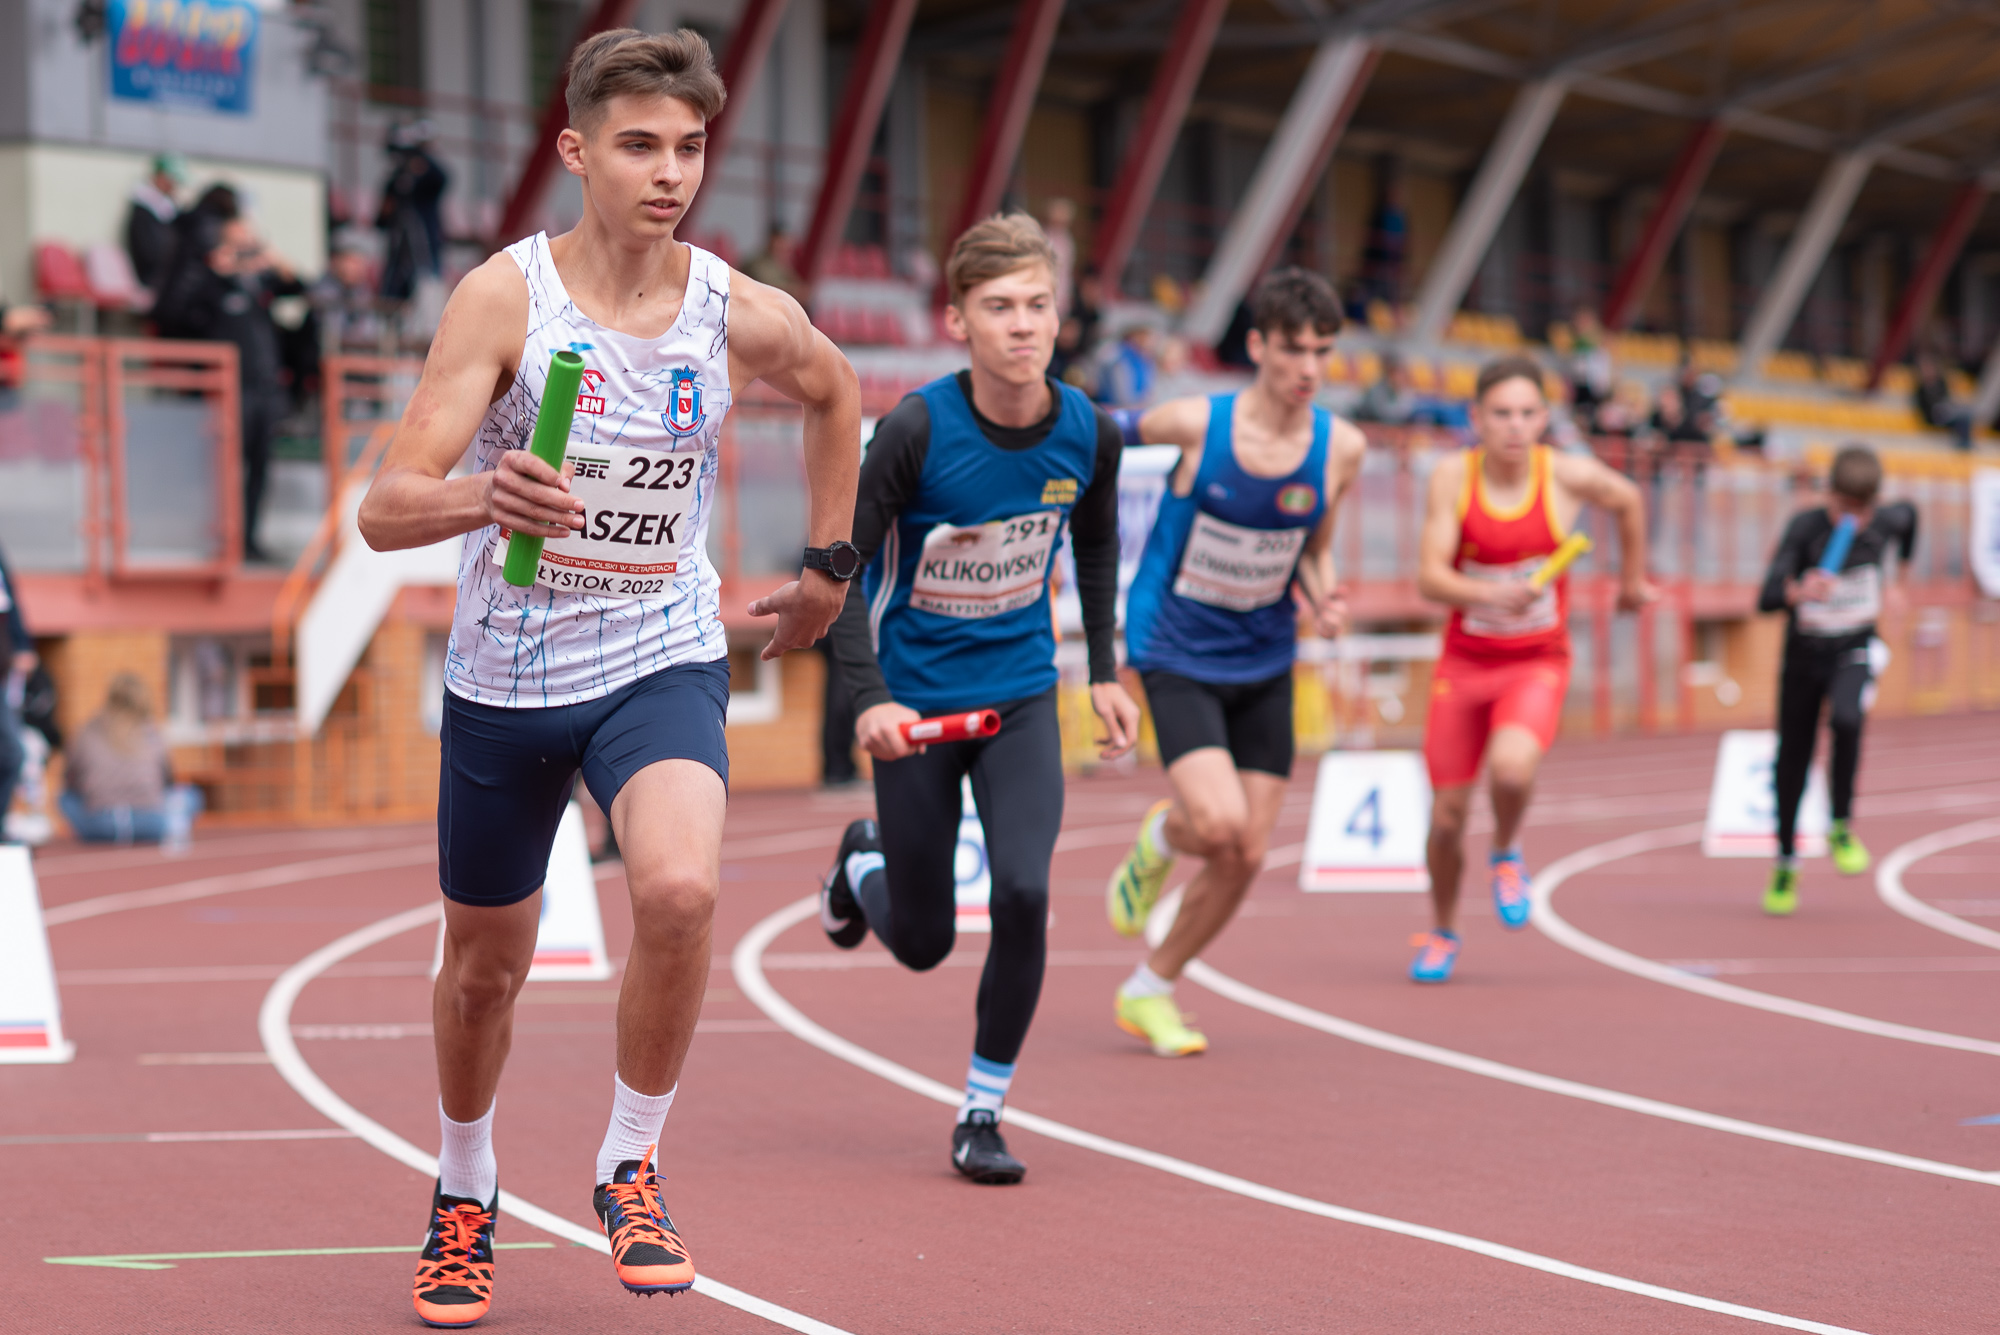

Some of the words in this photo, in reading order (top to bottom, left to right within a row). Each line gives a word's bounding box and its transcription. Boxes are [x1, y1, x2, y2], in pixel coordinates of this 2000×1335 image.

[575, 396, 603, 413] LEN
[573, 462, 610, 480] BET
[622, 456, 695, 491] 223
[568, 508, 682, 545] ASZEK
[1001, 516, 1050, 547] 291
[541, 551, 587, 567] TRZOSTWA
[588, 560, 618, 571] POLSKI
[619, 564, 629, 572] W
[629, 563, 675, 574] SZTAFETACH
[923, 549, 1046, 583] KLIKOWSKI
[537, 565, 614, 592] ŁYSTOK
[618, 579, 664, 595] 2022
[1346, 788, 1391, 850] 4
